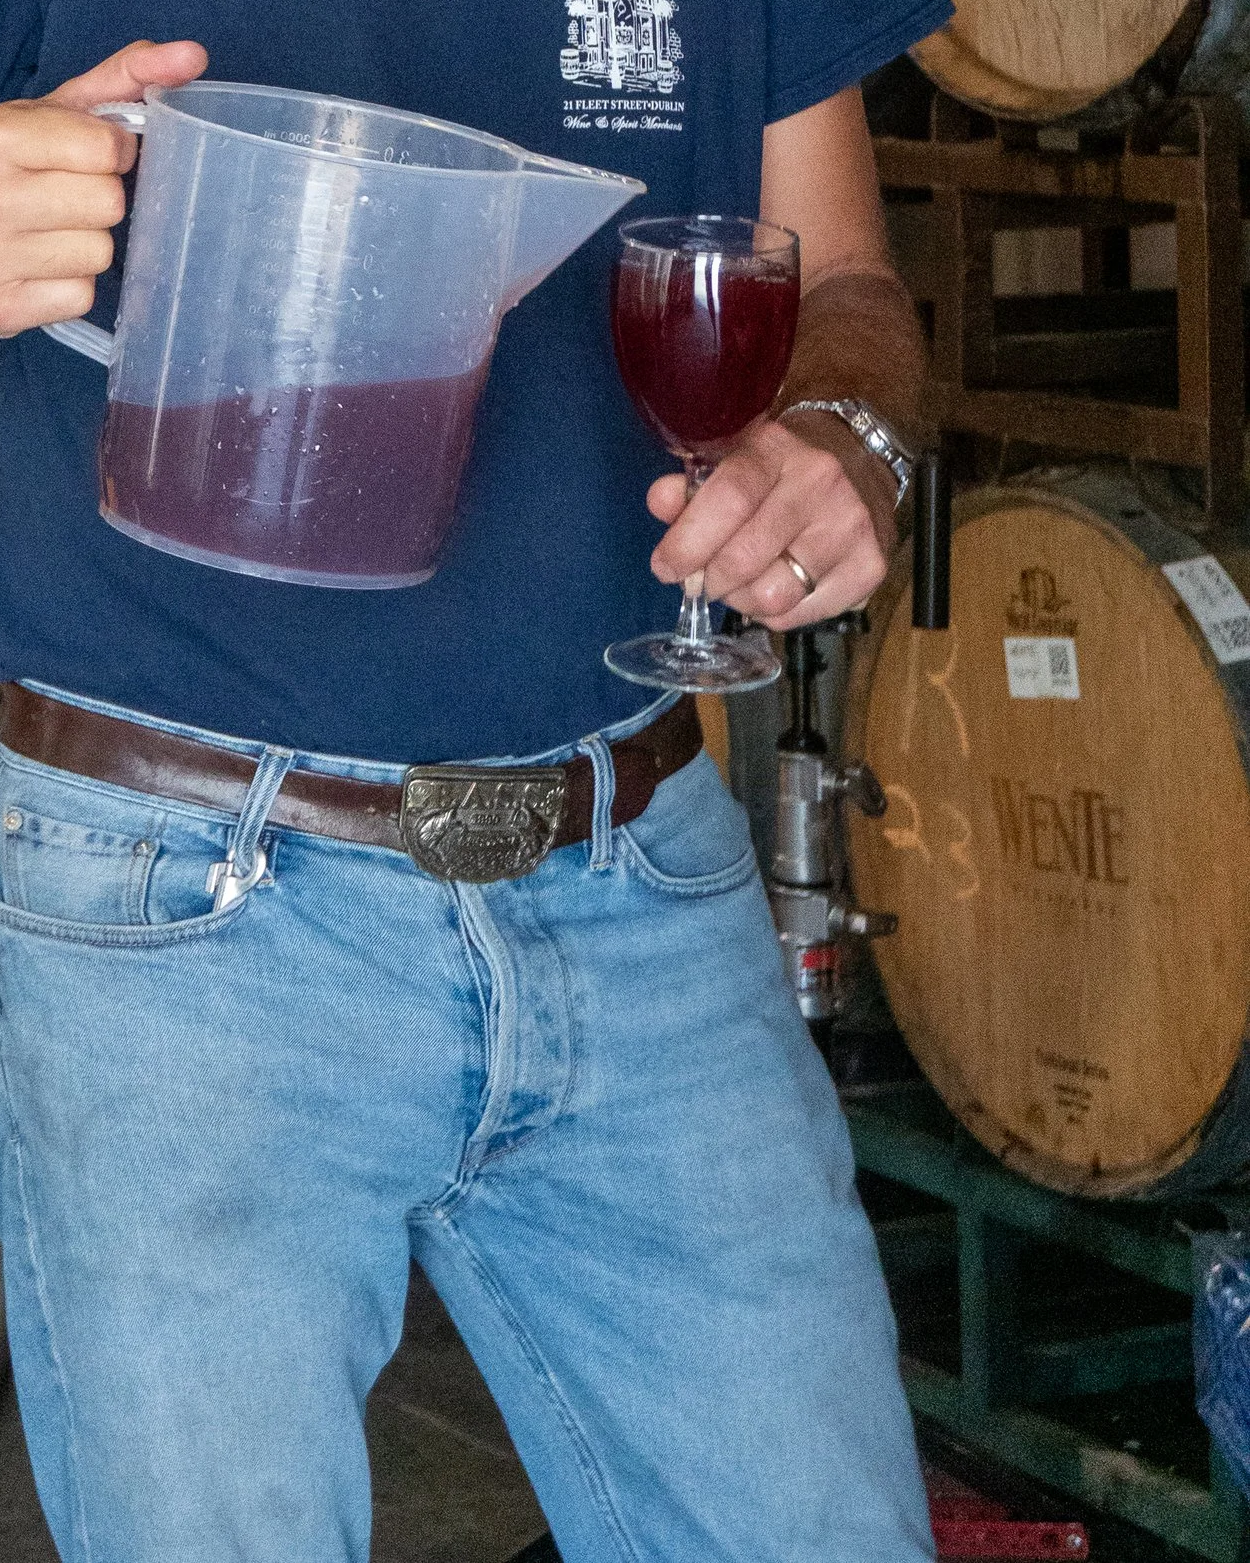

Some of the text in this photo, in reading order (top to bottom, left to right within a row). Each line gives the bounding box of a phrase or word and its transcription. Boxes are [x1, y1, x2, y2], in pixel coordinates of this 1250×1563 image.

[562, 99, 574, 111] 21
[575, 99, 610, 111] FLEET
[563, 113, 591, 129] Wine
[991, 775, 1131, 887] WENTE
